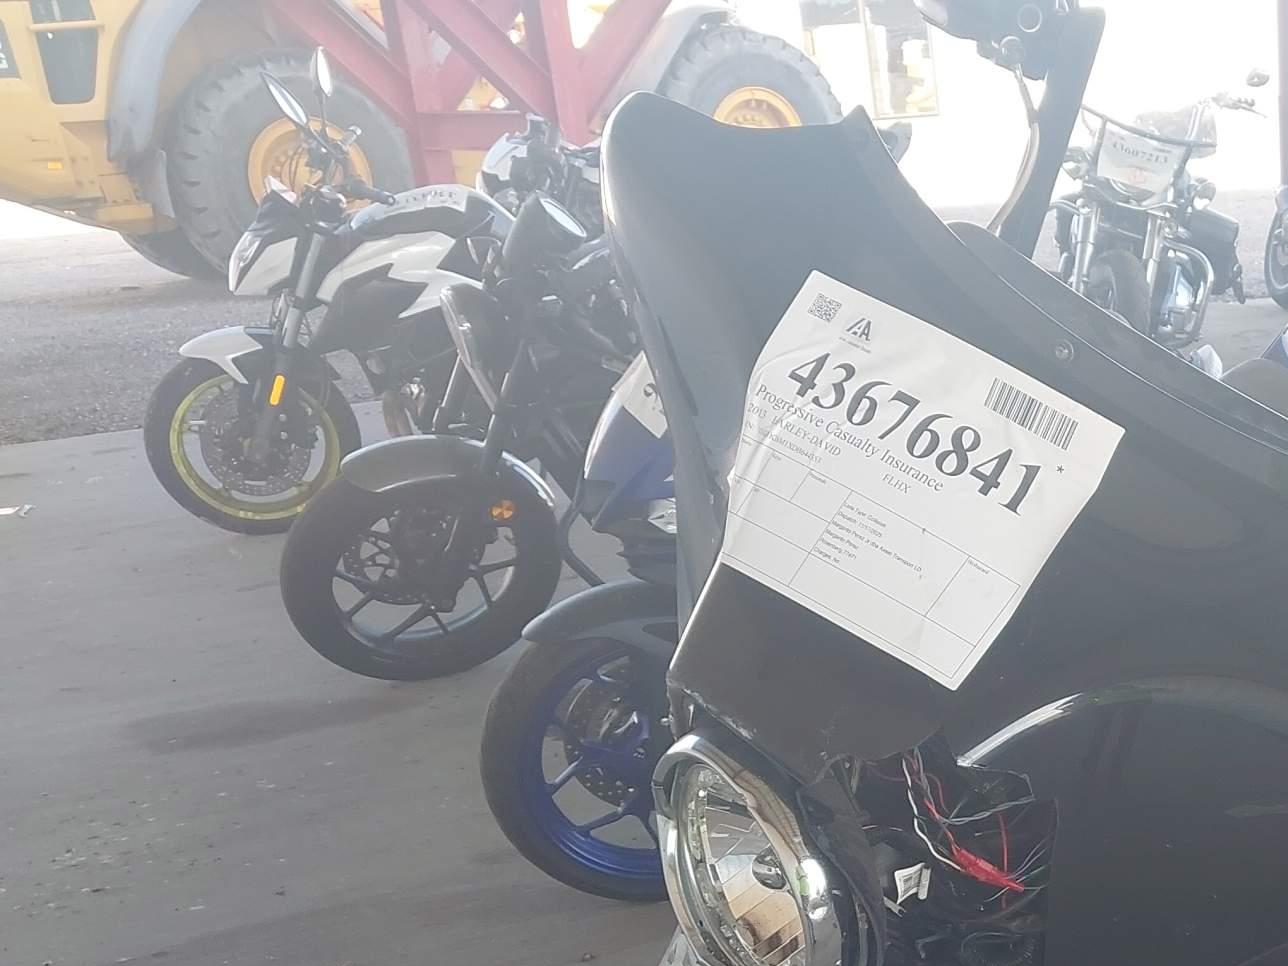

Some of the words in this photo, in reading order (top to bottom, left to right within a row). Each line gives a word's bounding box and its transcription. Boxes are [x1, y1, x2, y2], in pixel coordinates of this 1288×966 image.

[756, 384, 824, 427] Progressive
[825, 420, 880, 458] Casualty
[880, 449, 944, 491] Insurance
[788, 353, 1041, 516] 43676841
[882, 473, 911, 494] FLHX
